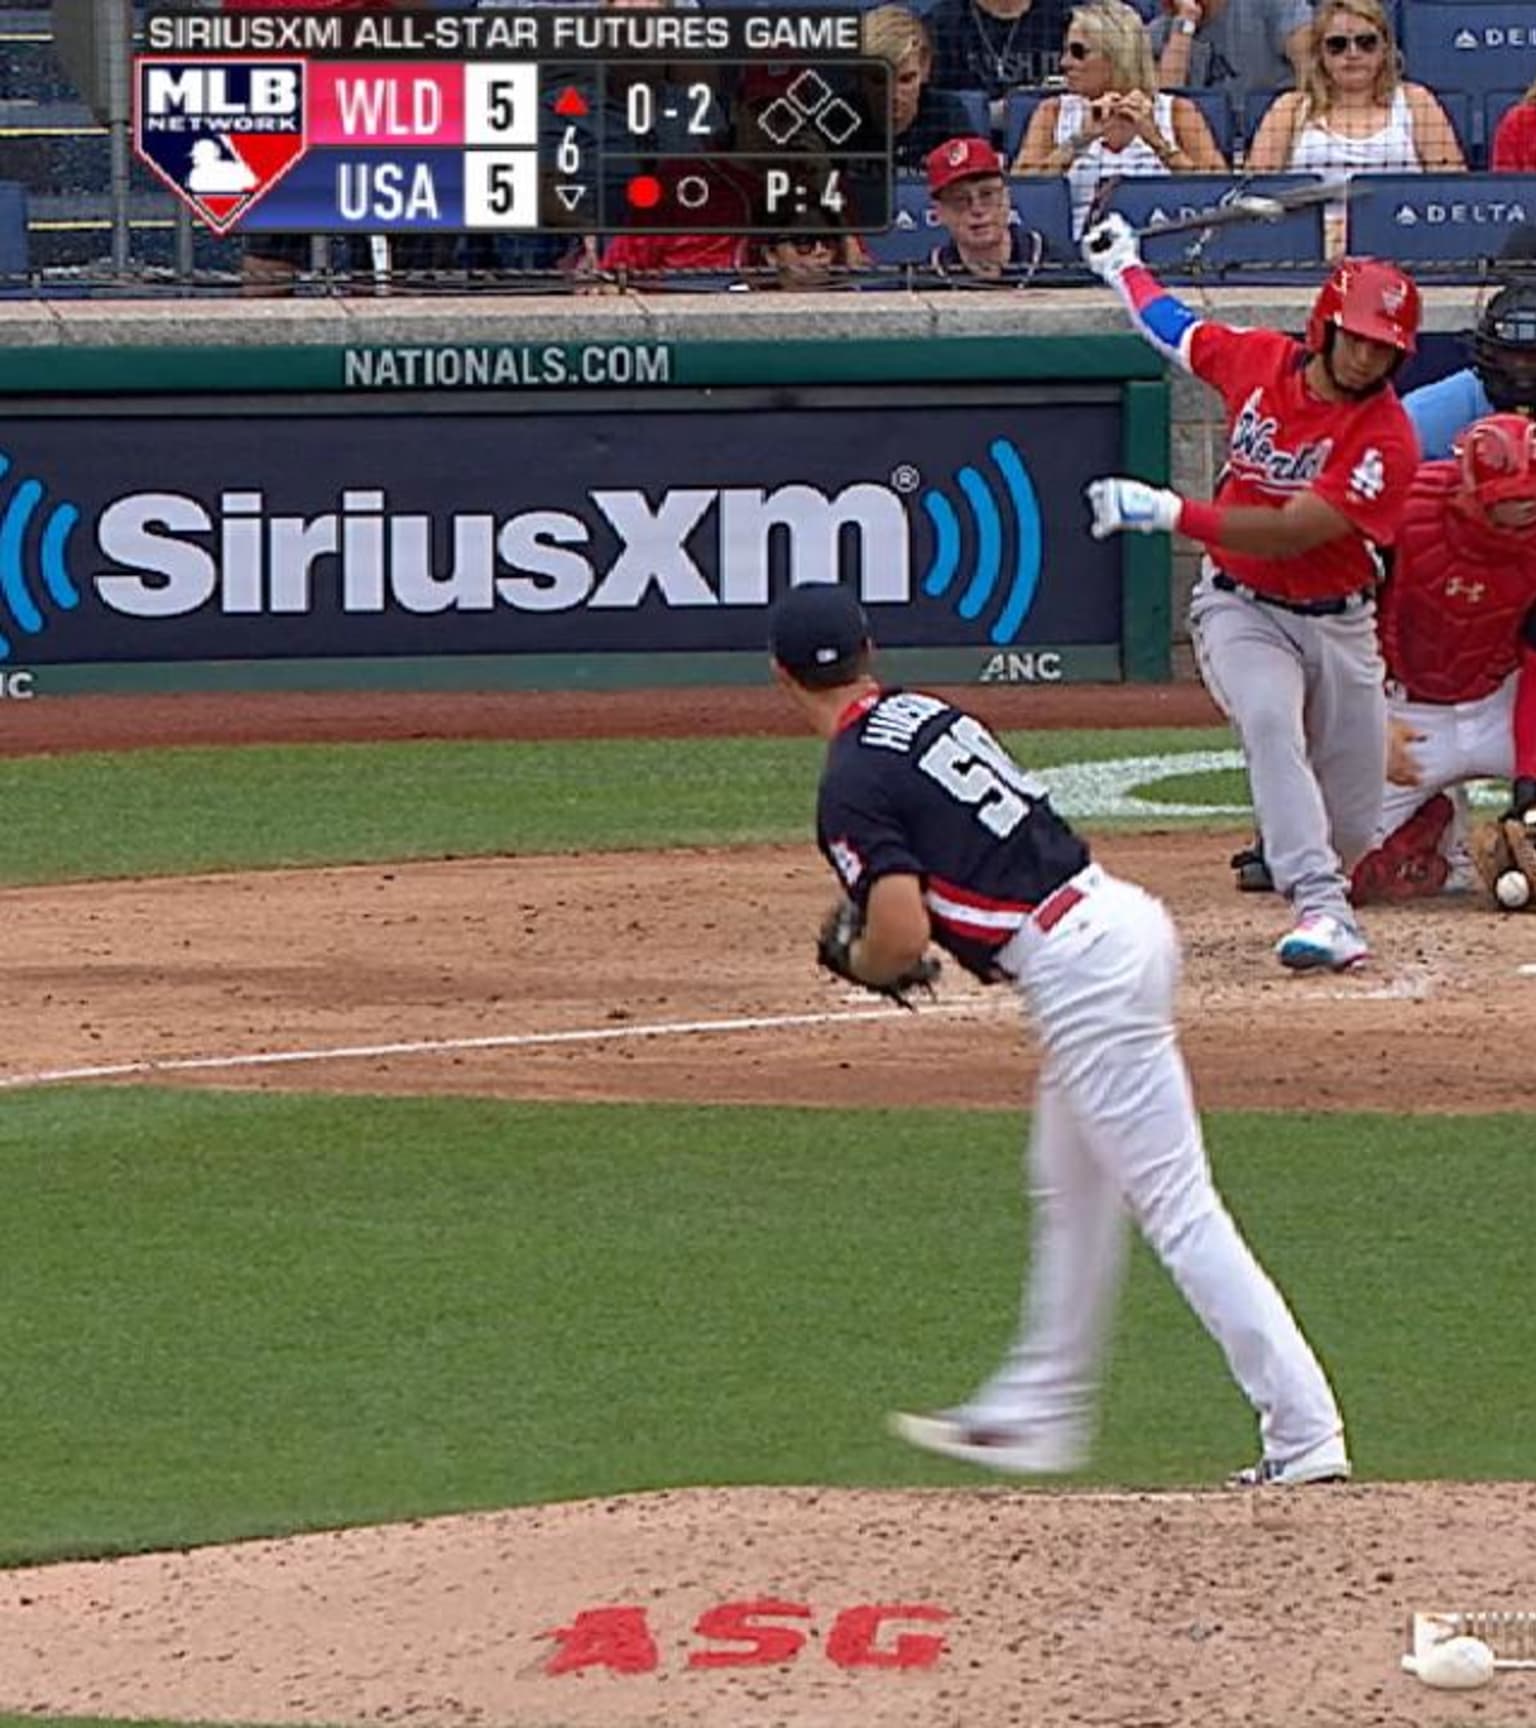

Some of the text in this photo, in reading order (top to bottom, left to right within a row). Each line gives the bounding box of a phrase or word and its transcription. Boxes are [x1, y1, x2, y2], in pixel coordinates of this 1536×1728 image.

[1427, 203, 1527, 223] DELTA
[343, 345, 671, 387] NATIONALS.COM
[979, 653, 1063, 682] ANC
[918, 715, 1049, 840] 50
[545, 1598, 960, 1677] ASG
